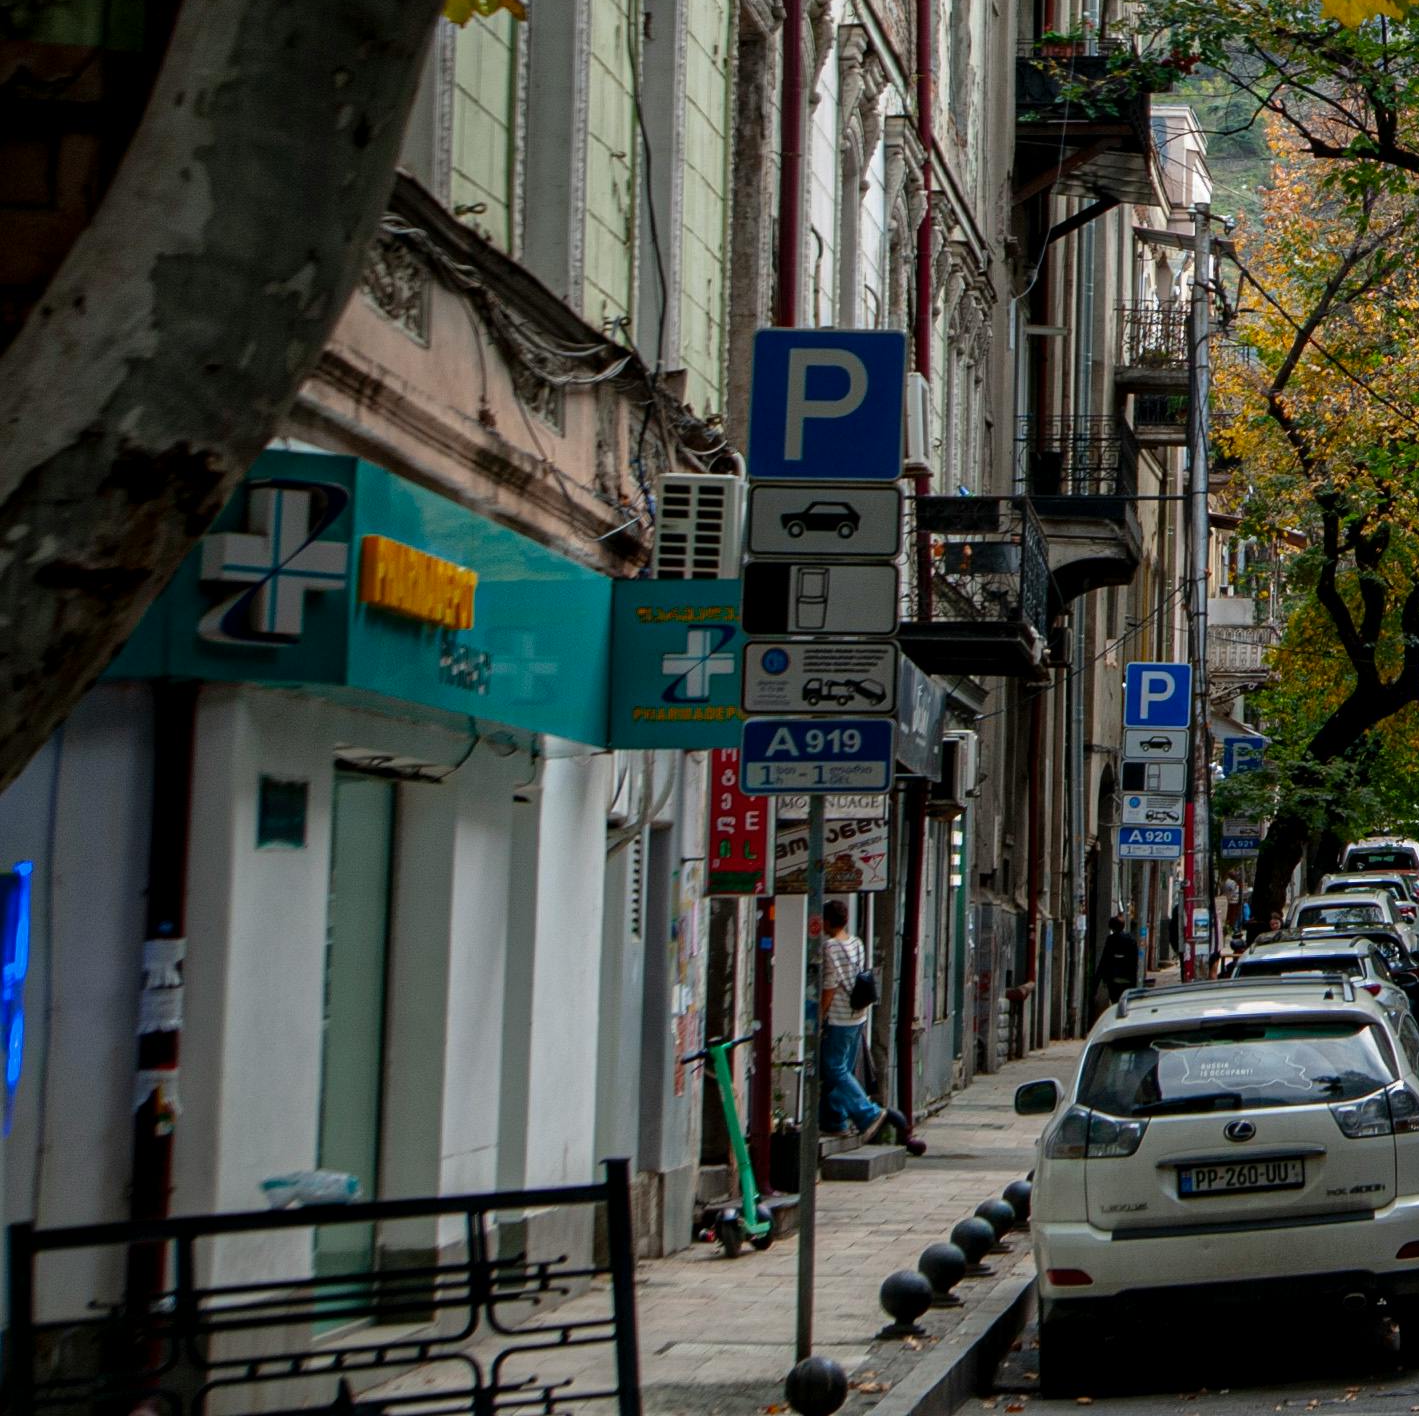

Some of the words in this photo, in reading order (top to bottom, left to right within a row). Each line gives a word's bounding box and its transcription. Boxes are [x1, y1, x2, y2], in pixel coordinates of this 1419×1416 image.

[784, 347, 868, 461] P
[1139, 670, 1175, 720] P
[765, 727, 799, 757] A
[805, 729, 862, 754] 919
[761, 765, 775, 785] 1
[812, 765, 826, 785] 1
[1128, 830, 1143, 843] A
[1145, 831, 1172, 842] 920
[1195, 1162, 1289, 1189] PP-260-UU
